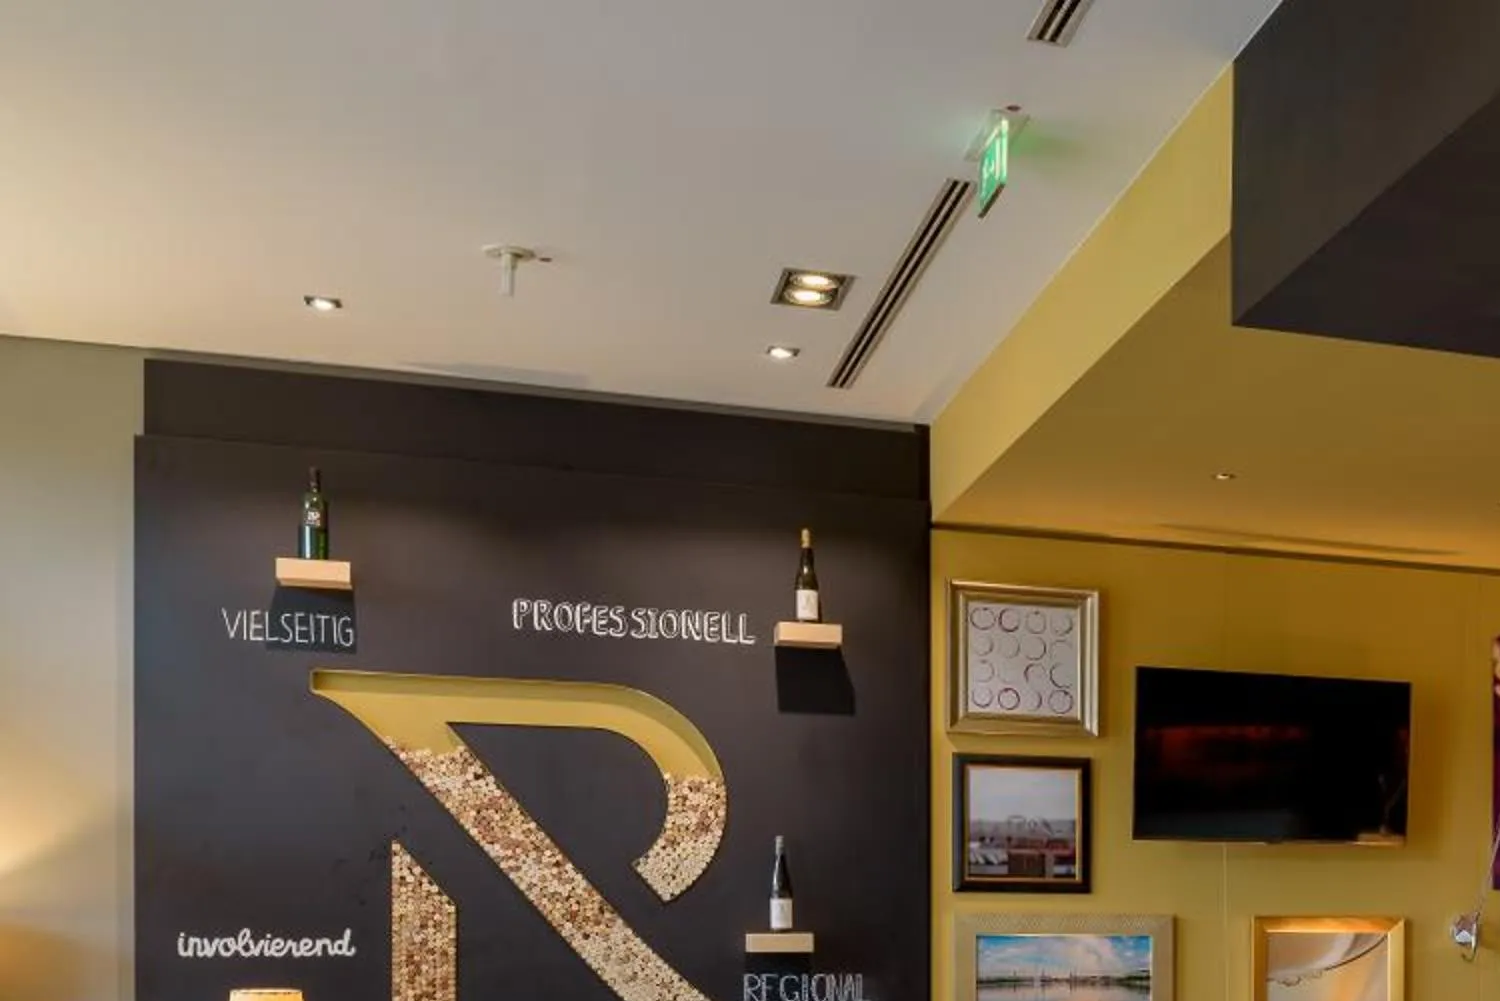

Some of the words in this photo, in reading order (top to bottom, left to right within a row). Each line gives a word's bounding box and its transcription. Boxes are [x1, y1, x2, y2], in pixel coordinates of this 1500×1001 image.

[221, 606, 354, 647] VIELSEITIG
[512, 597, 757, 645] PROFESSIONELL
[177, 927, 356, 958] involvierend
